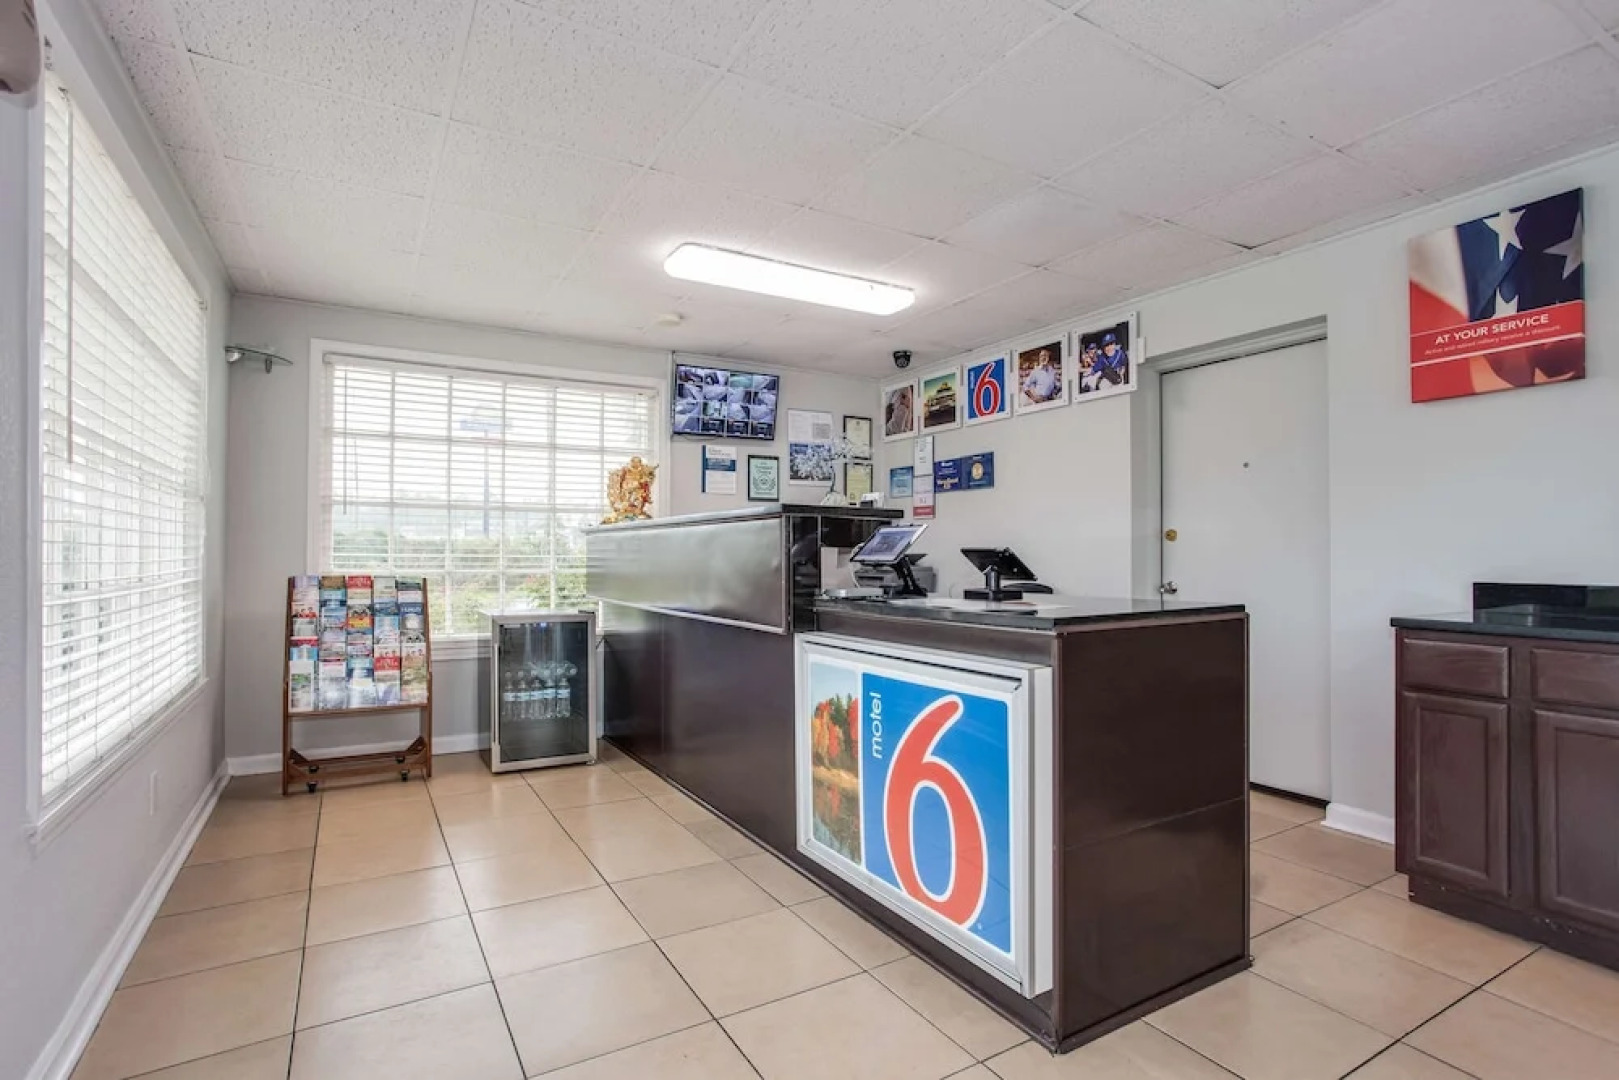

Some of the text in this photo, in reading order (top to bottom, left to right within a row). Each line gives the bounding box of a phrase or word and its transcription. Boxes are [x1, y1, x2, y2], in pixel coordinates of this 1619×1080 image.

[1435, 313, 1549, 346] AT YOUR SERVICE
[973, 361, 1001, 418] 6
[870, 692, 883, 760] motel
[883, 694, 988, 930] 6
